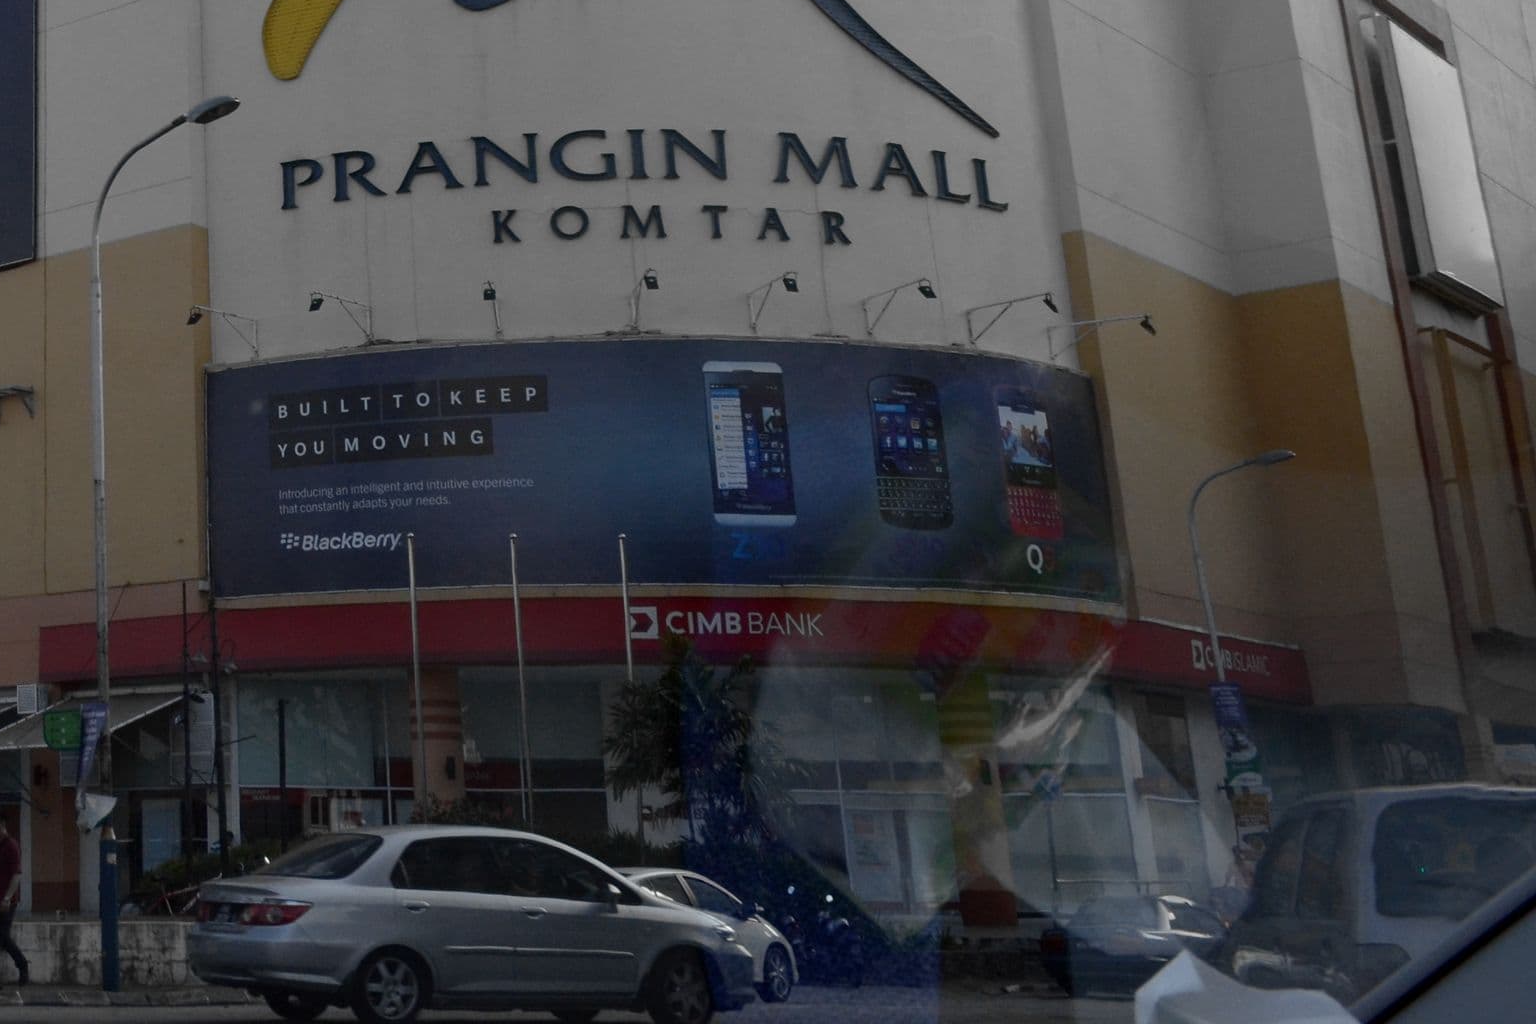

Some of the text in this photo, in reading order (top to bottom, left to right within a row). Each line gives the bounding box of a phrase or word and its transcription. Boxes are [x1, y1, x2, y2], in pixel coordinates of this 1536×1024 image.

[279, 128, 1009, 214] PRANGIN MALL
[492, 204, 853, 245] KOMTAR
[277, 386, 537, 419] BUILT TO KEEP
[277, 429, 484, 458] YOU MOVING
[279, 476, 535, 501] Introducing an intelligent and intuitive experience
[279, 494, 451, 516] that constantly adapts your needs.
[301, 531, 401, 552] BlackBerry
[665, 610, 824, 636] CIMB BANK
